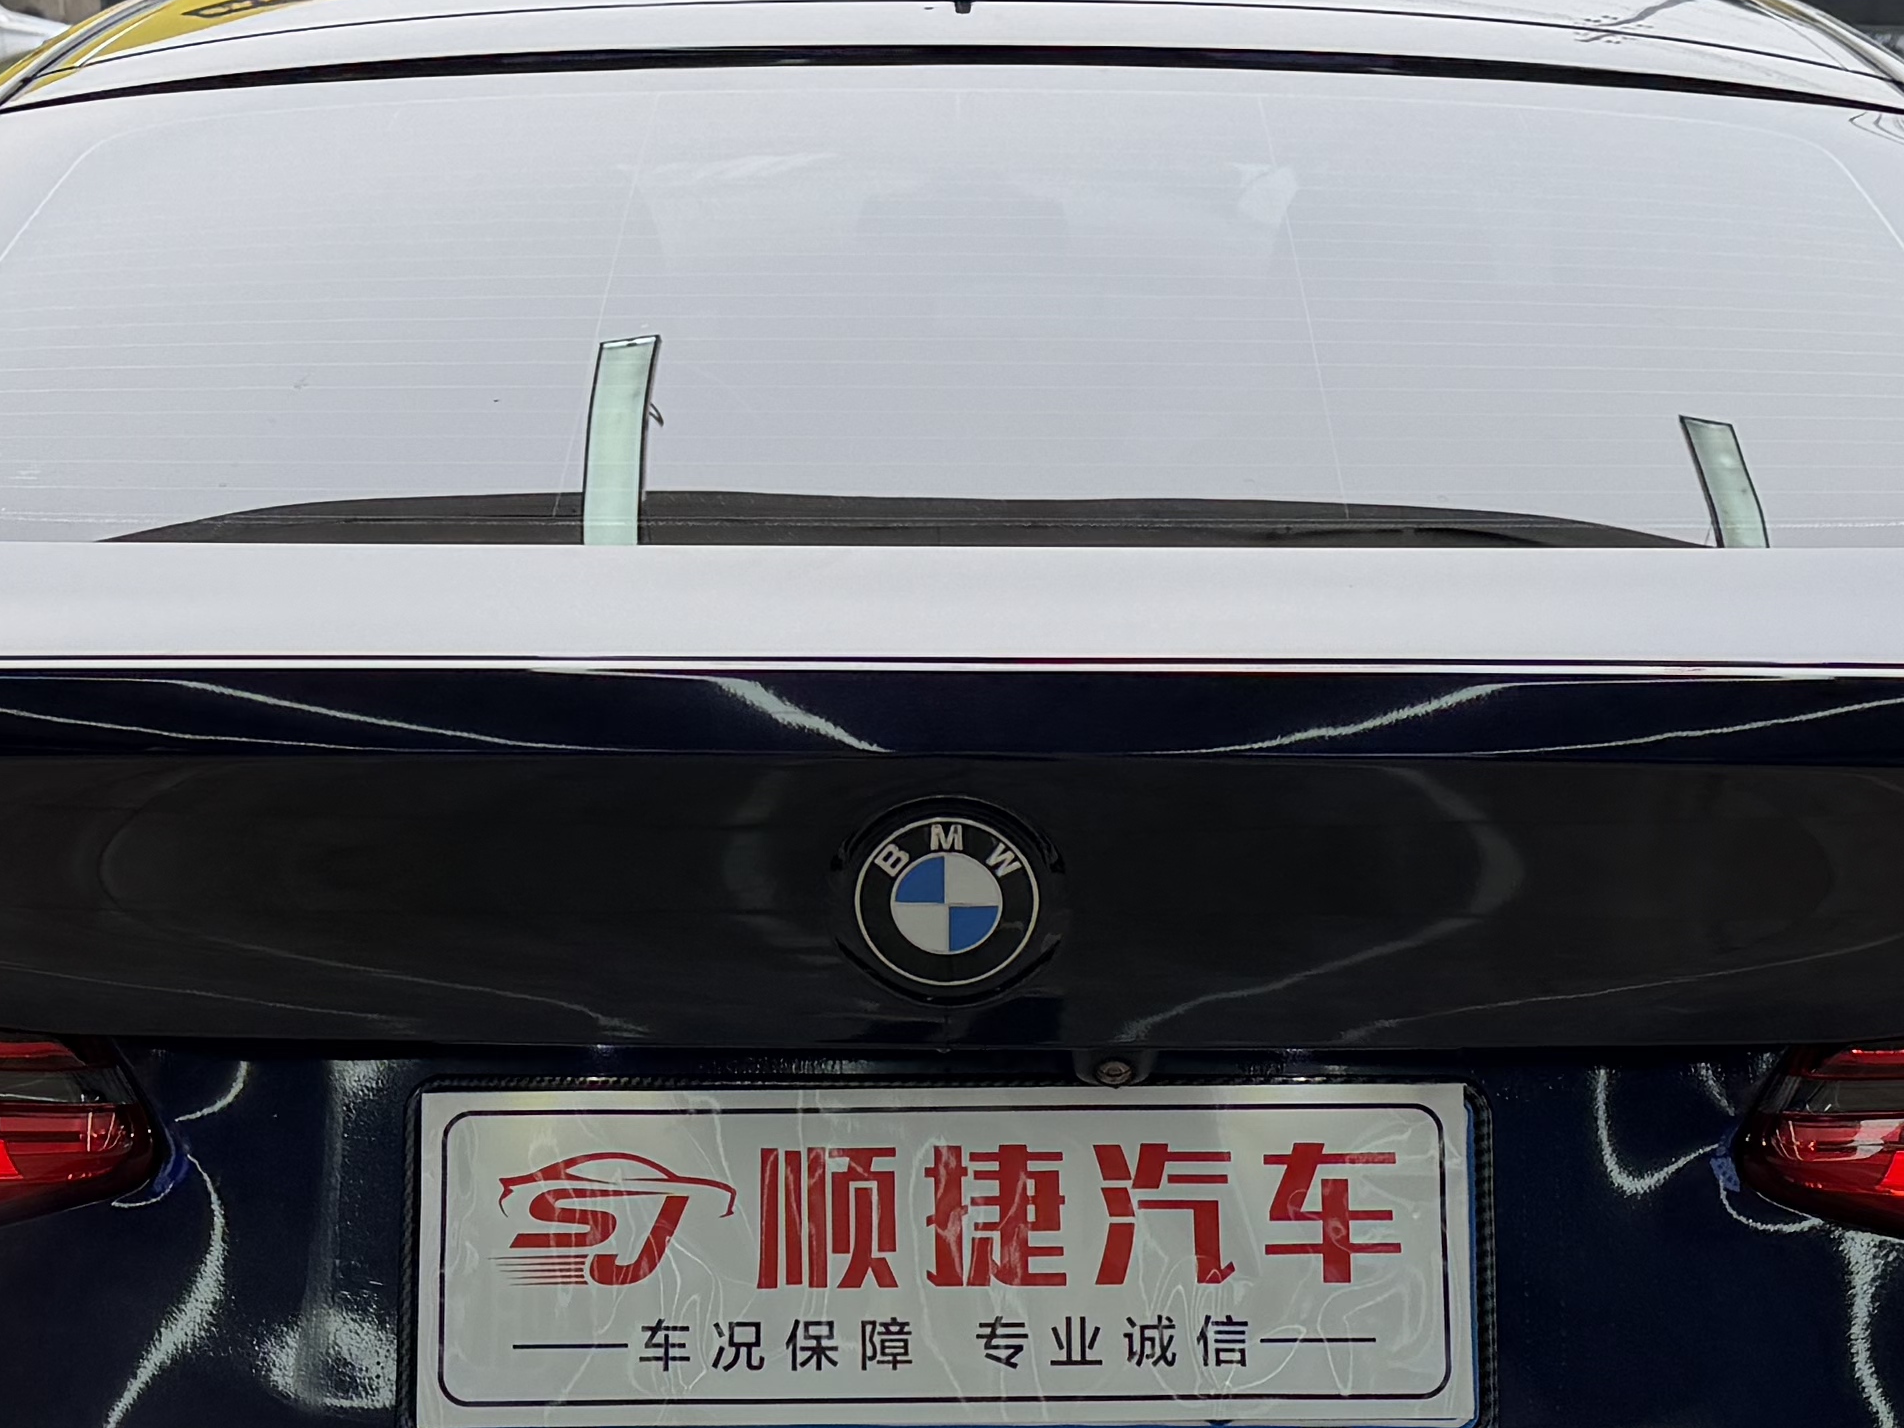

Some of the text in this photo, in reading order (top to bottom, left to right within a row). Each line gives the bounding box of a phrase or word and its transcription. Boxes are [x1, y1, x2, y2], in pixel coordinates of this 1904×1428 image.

[874, 823, 1023, 878] BMW
[756, 1141, 1403, 1291] 顺捷汽车
[638, 1313, 1250, 1373] 车况保障 专业诚信
